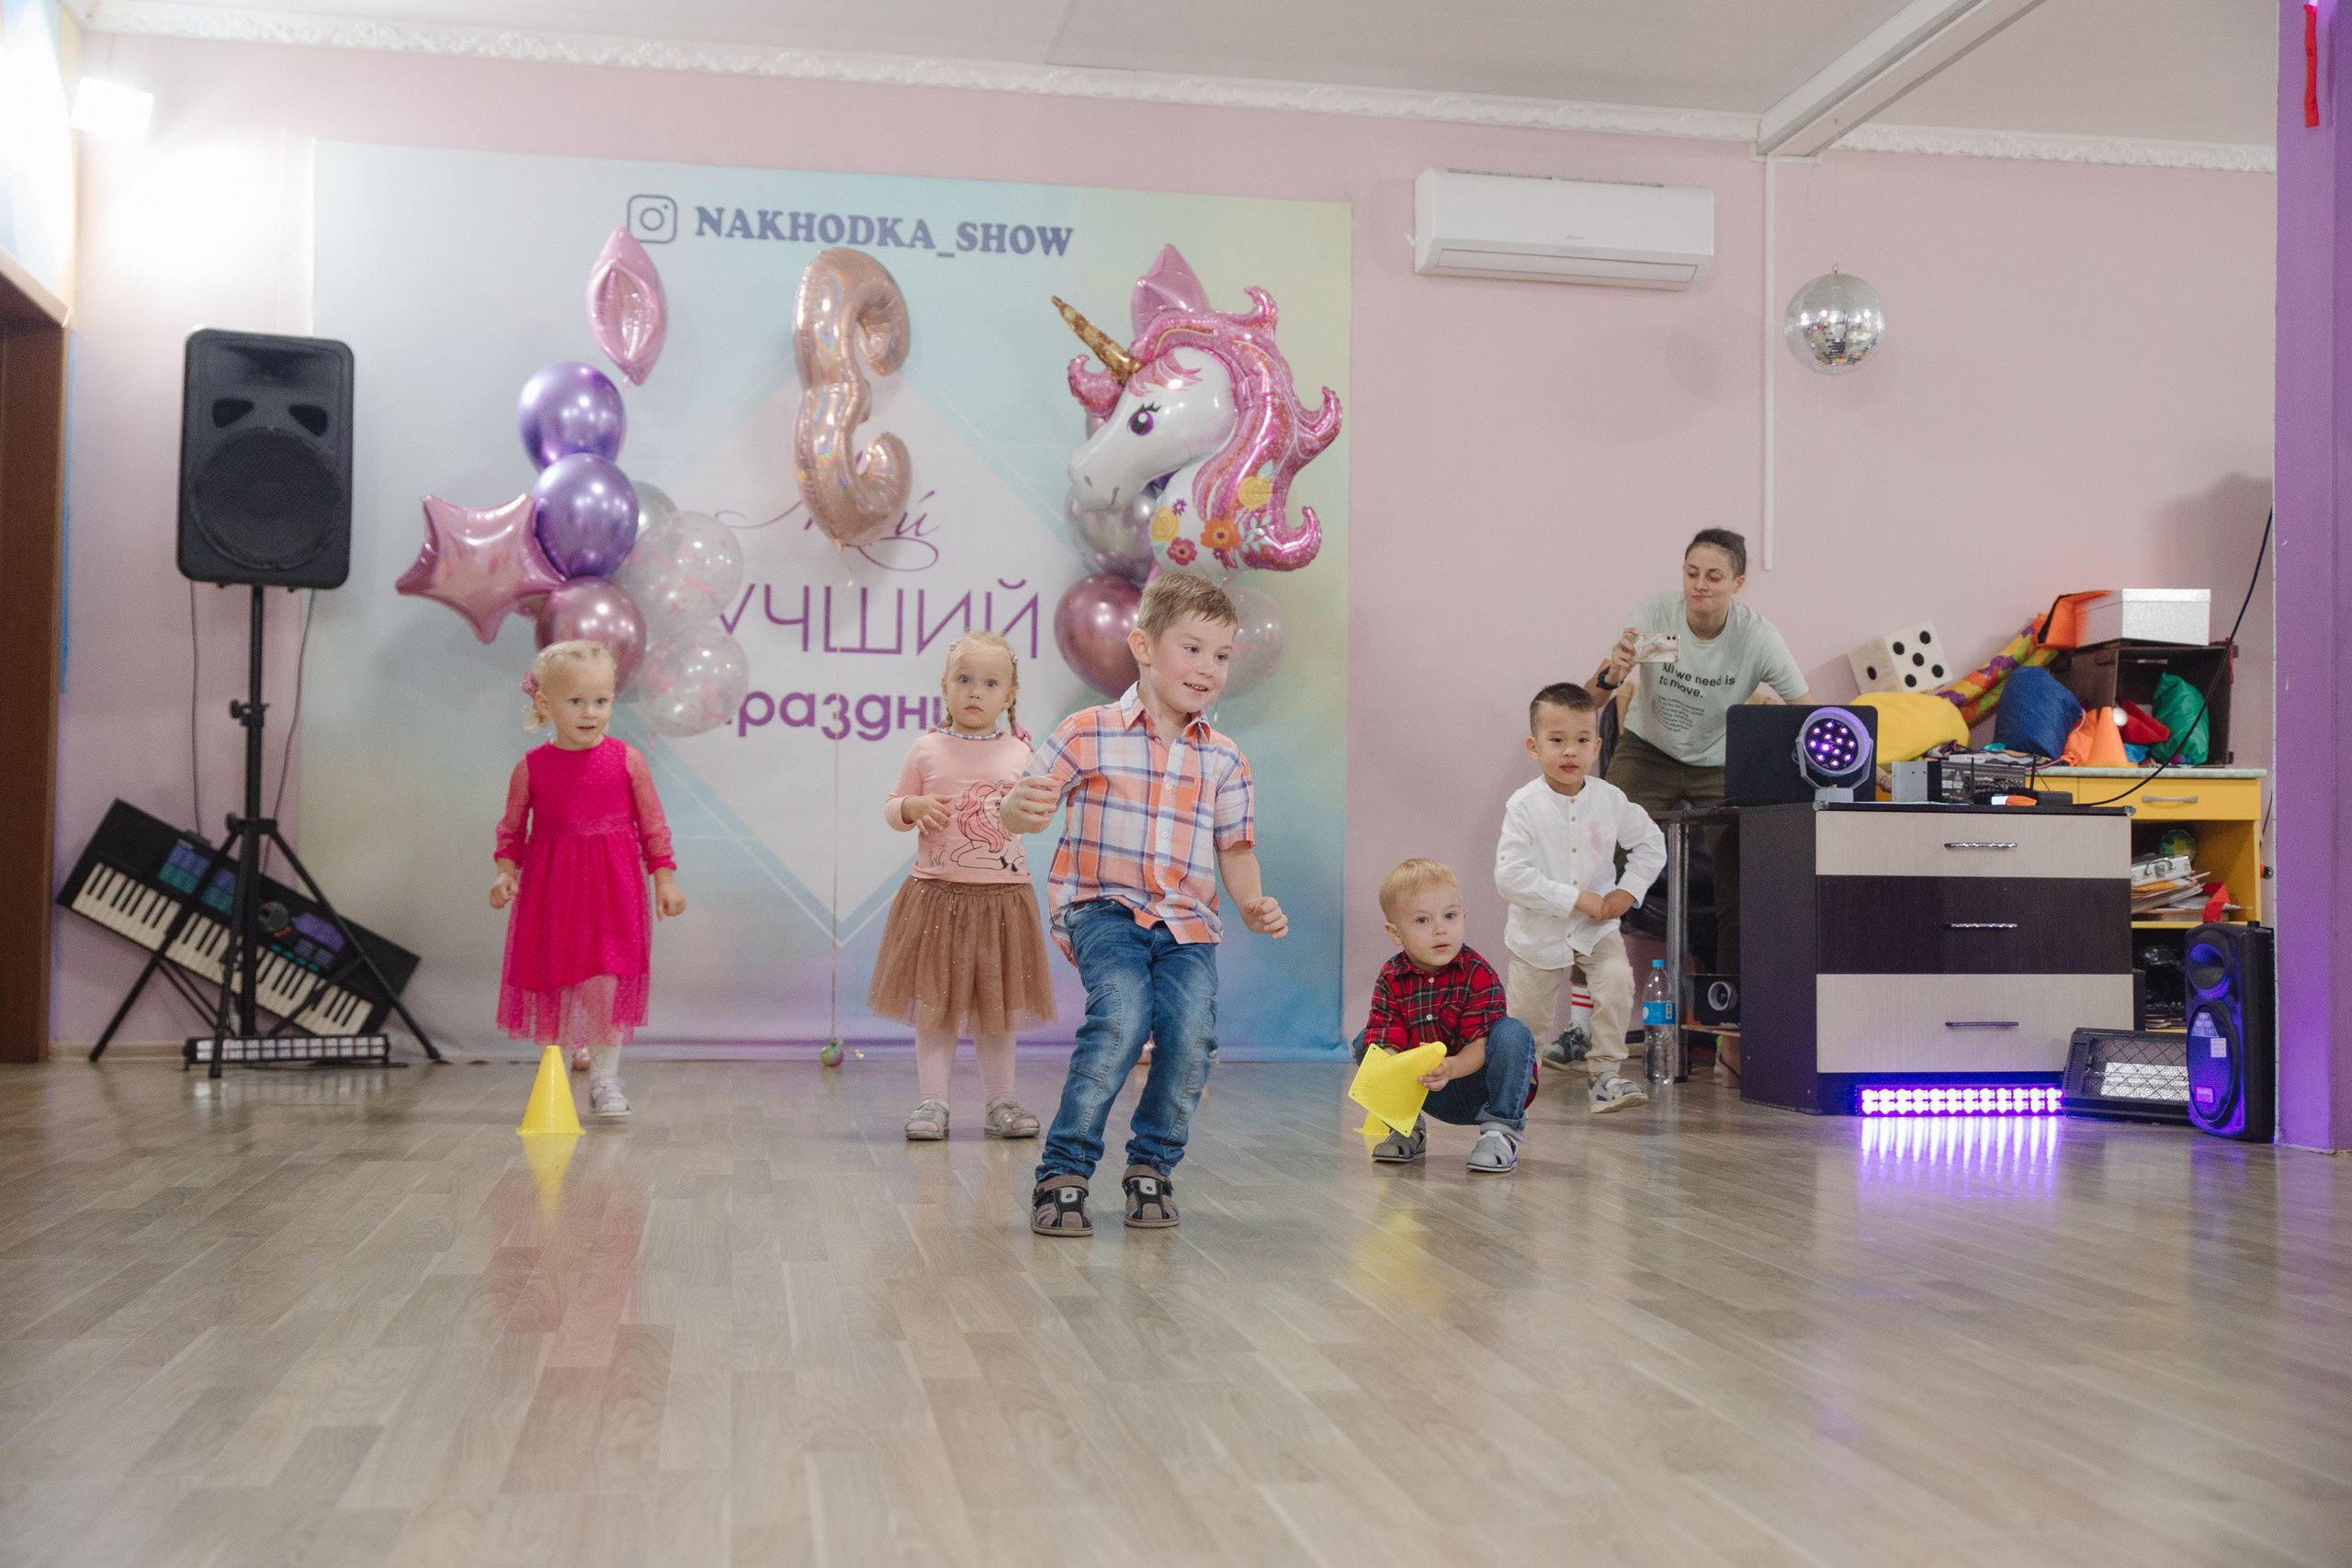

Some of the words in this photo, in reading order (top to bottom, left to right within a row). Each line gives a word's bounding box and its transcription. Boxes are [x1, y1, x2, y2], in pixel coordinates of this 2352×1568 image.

[695, 206, 1073, 257] NAKHODKA_SHOW
[719, 579, 1039, 659] УЧШИЙ
[1659, 675, 1668, 686] to
[1669, 679, 1703, 698] move.
[1676, 670, 1692, 682] we
[1695, 674, 1723, 687] need
[1724, 675, 1736, 685] is
